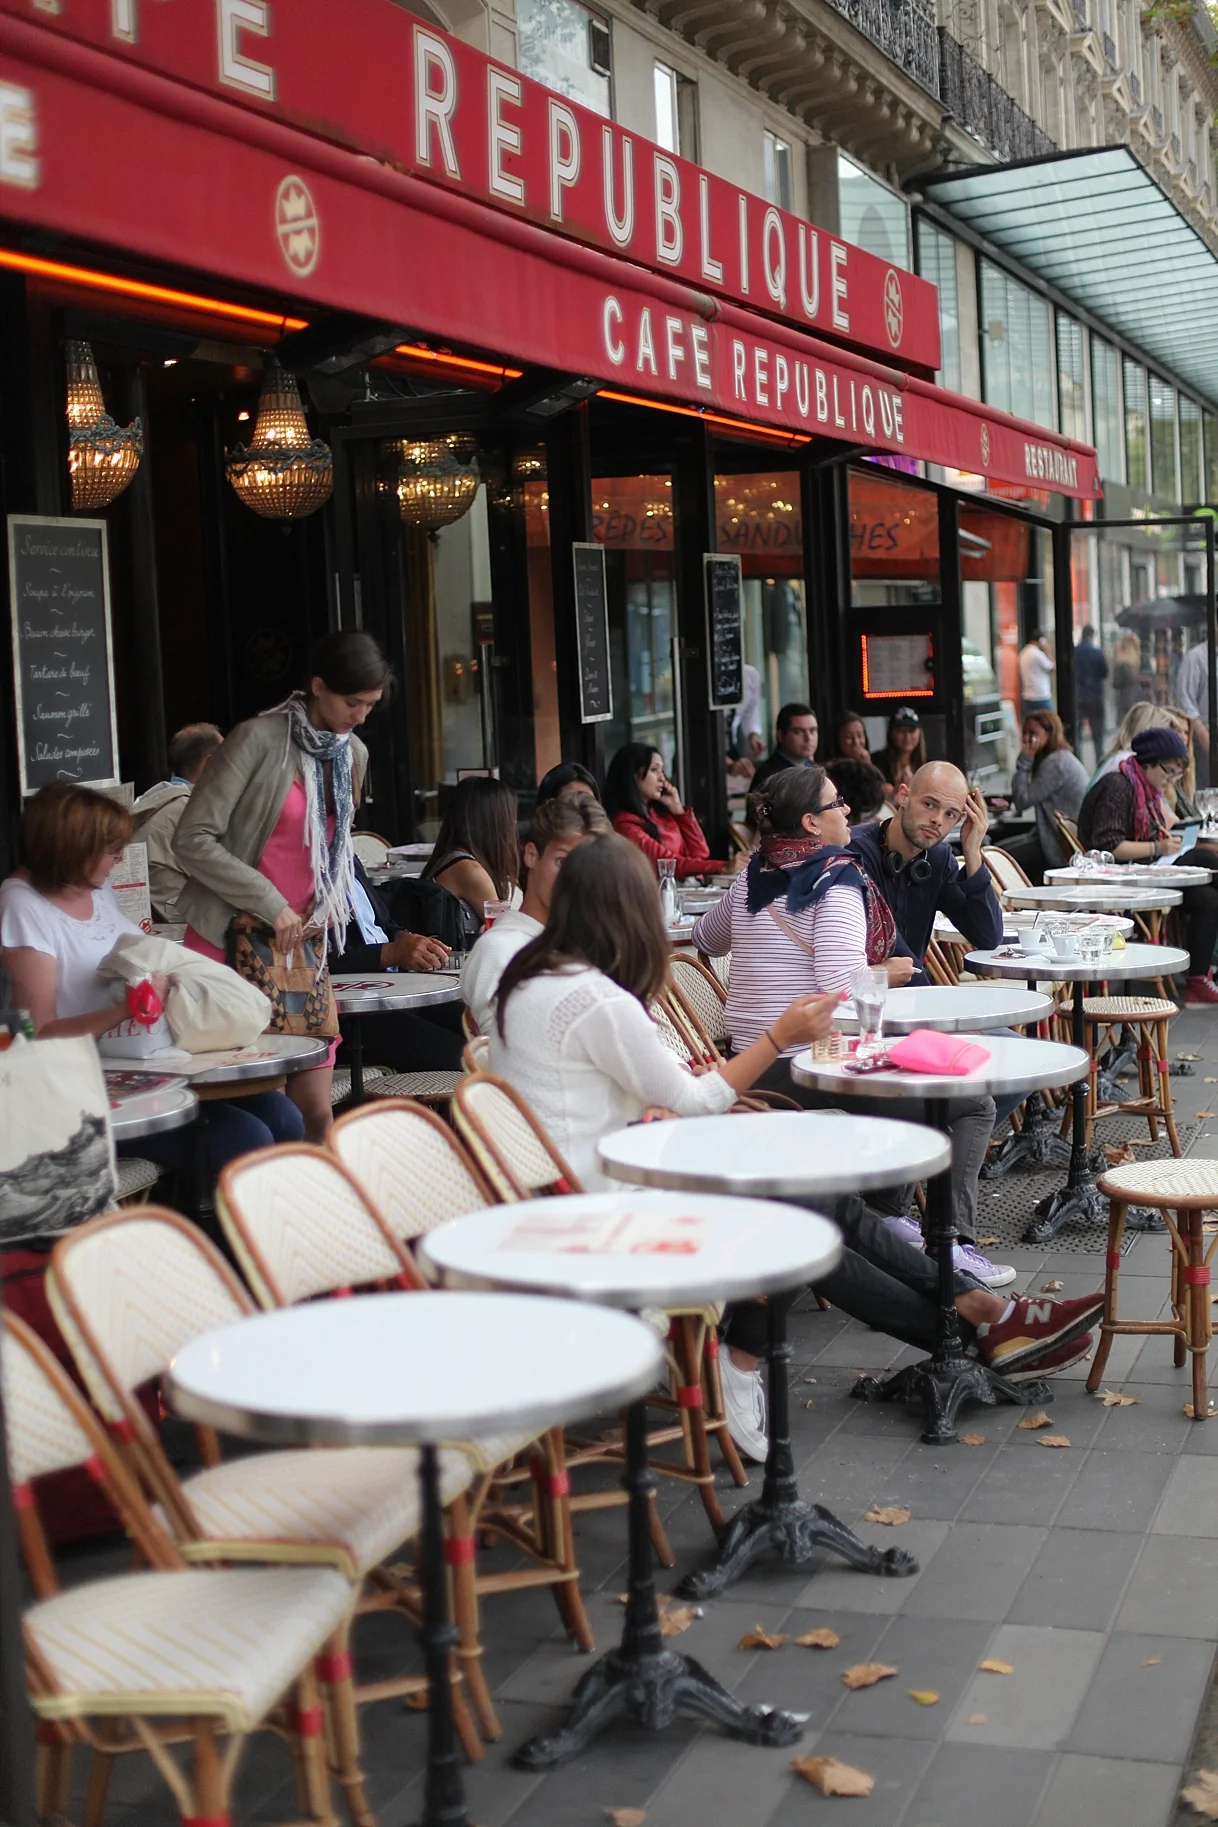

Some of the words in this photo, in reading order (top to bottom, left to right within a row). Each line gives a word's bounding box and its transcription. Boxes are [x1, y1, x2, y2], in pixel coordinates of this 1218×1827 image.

[413, 23, 850, 332] REPUBLIQUE
[603, 296, 711, 389] CAFE
[733, 339, 904, 443] REPUBLIQUE
[1024, 442, 1078, 489] RESTAURANT
[32, 703, 66, 720] Saumon
[30, 742, 63, 762] Salades
[1025, 1302, 1052, 1325] N
